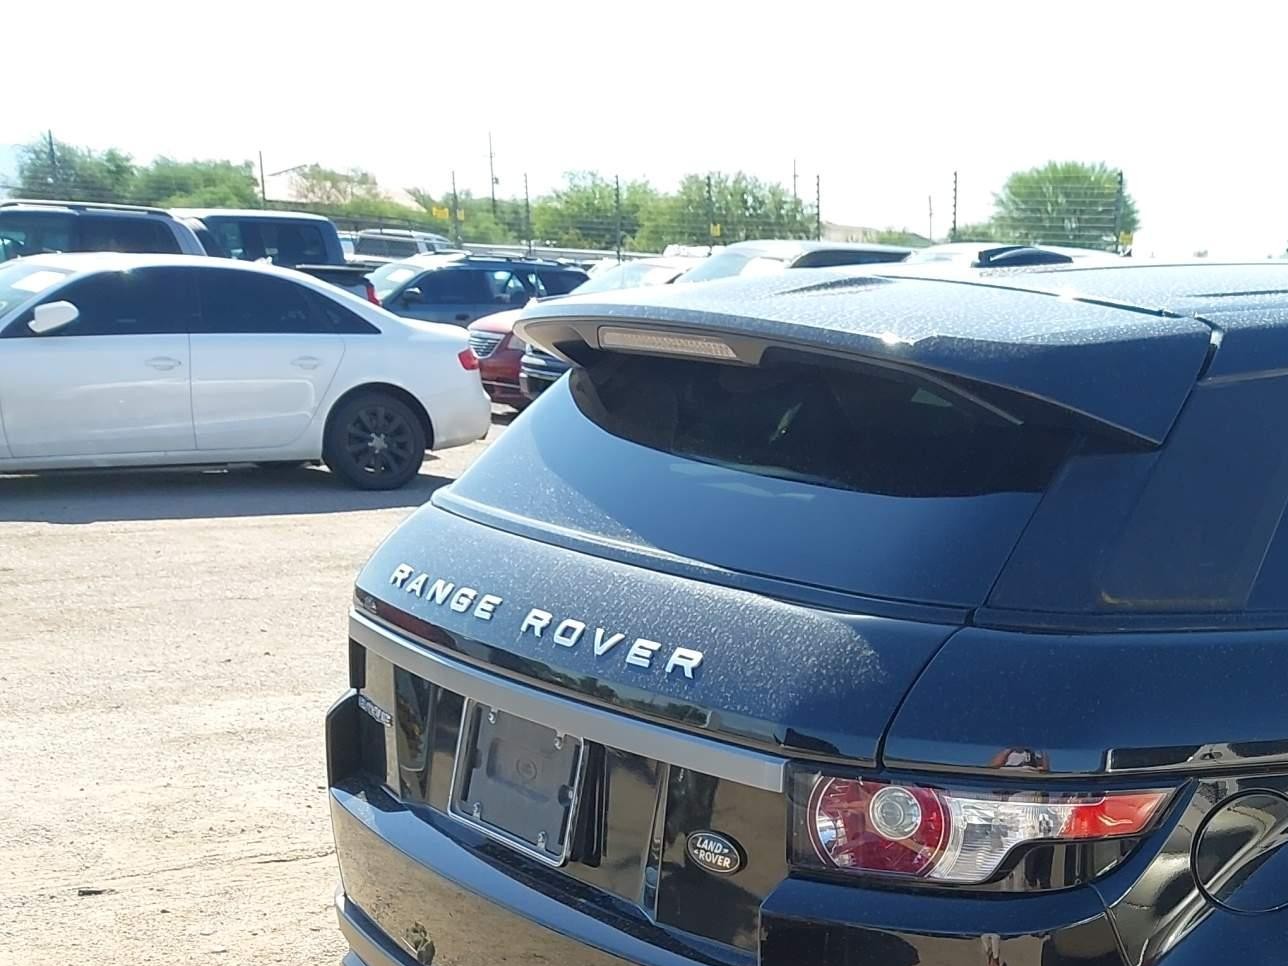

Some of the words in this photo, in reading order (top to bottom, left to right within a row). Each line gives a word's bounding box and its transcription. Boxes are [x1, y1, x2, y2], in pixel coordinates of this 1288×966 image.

[388, 563, 503, 621] RANGE
[520, 608, 704, 679] ROVER
[696, 837, 723, 853] LAND
[698, 850, 731, 869] ROVER
